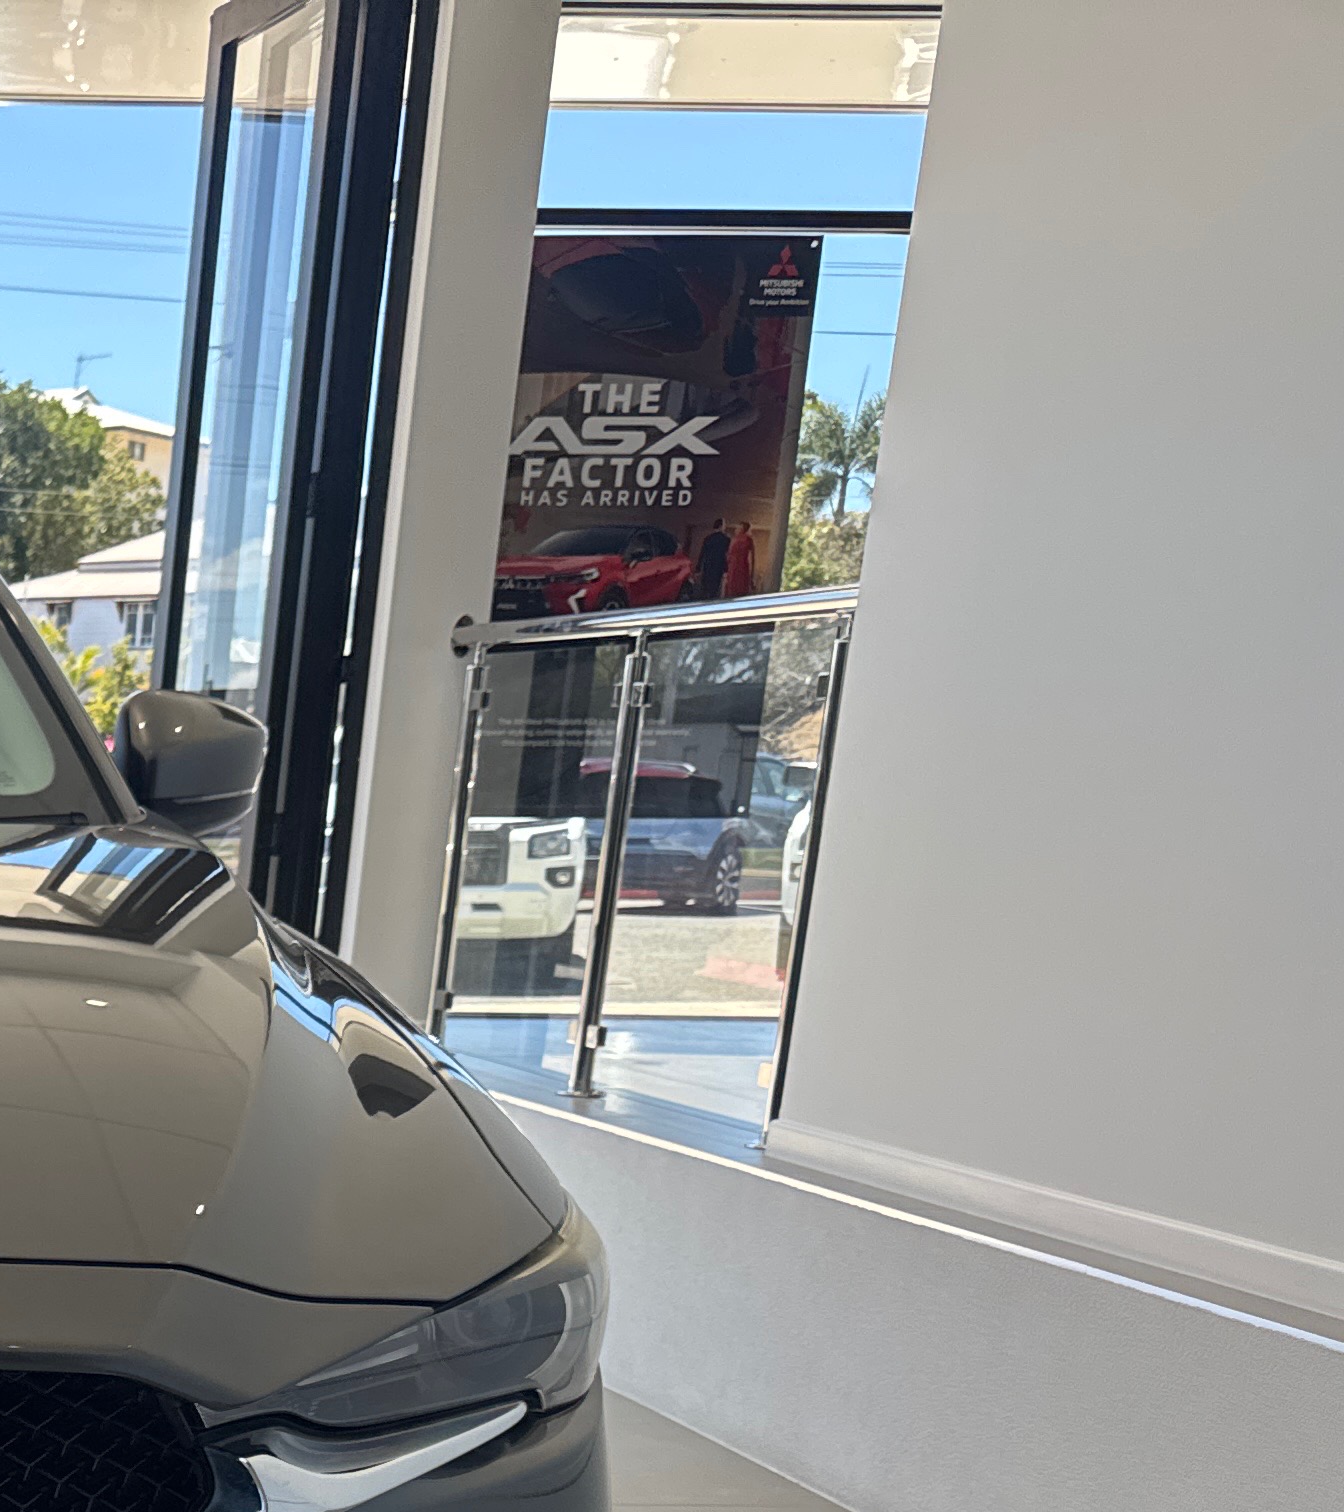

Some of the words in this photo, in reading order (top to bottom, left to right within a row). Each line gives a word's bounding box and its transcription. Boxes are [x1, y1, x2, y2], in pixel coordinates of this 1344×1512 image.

[759, 280, 805, 288] MITSUBISHI
[763, 288, 797, 296] MOTORS
[578, 383, 662, 414] THE
[509, 416, 720, 455] ASX
[522, 457, 693, 488] FACTOR
[520, 490, 568, 506] HAS
[581, 490, 692, 506] ARRIVED
